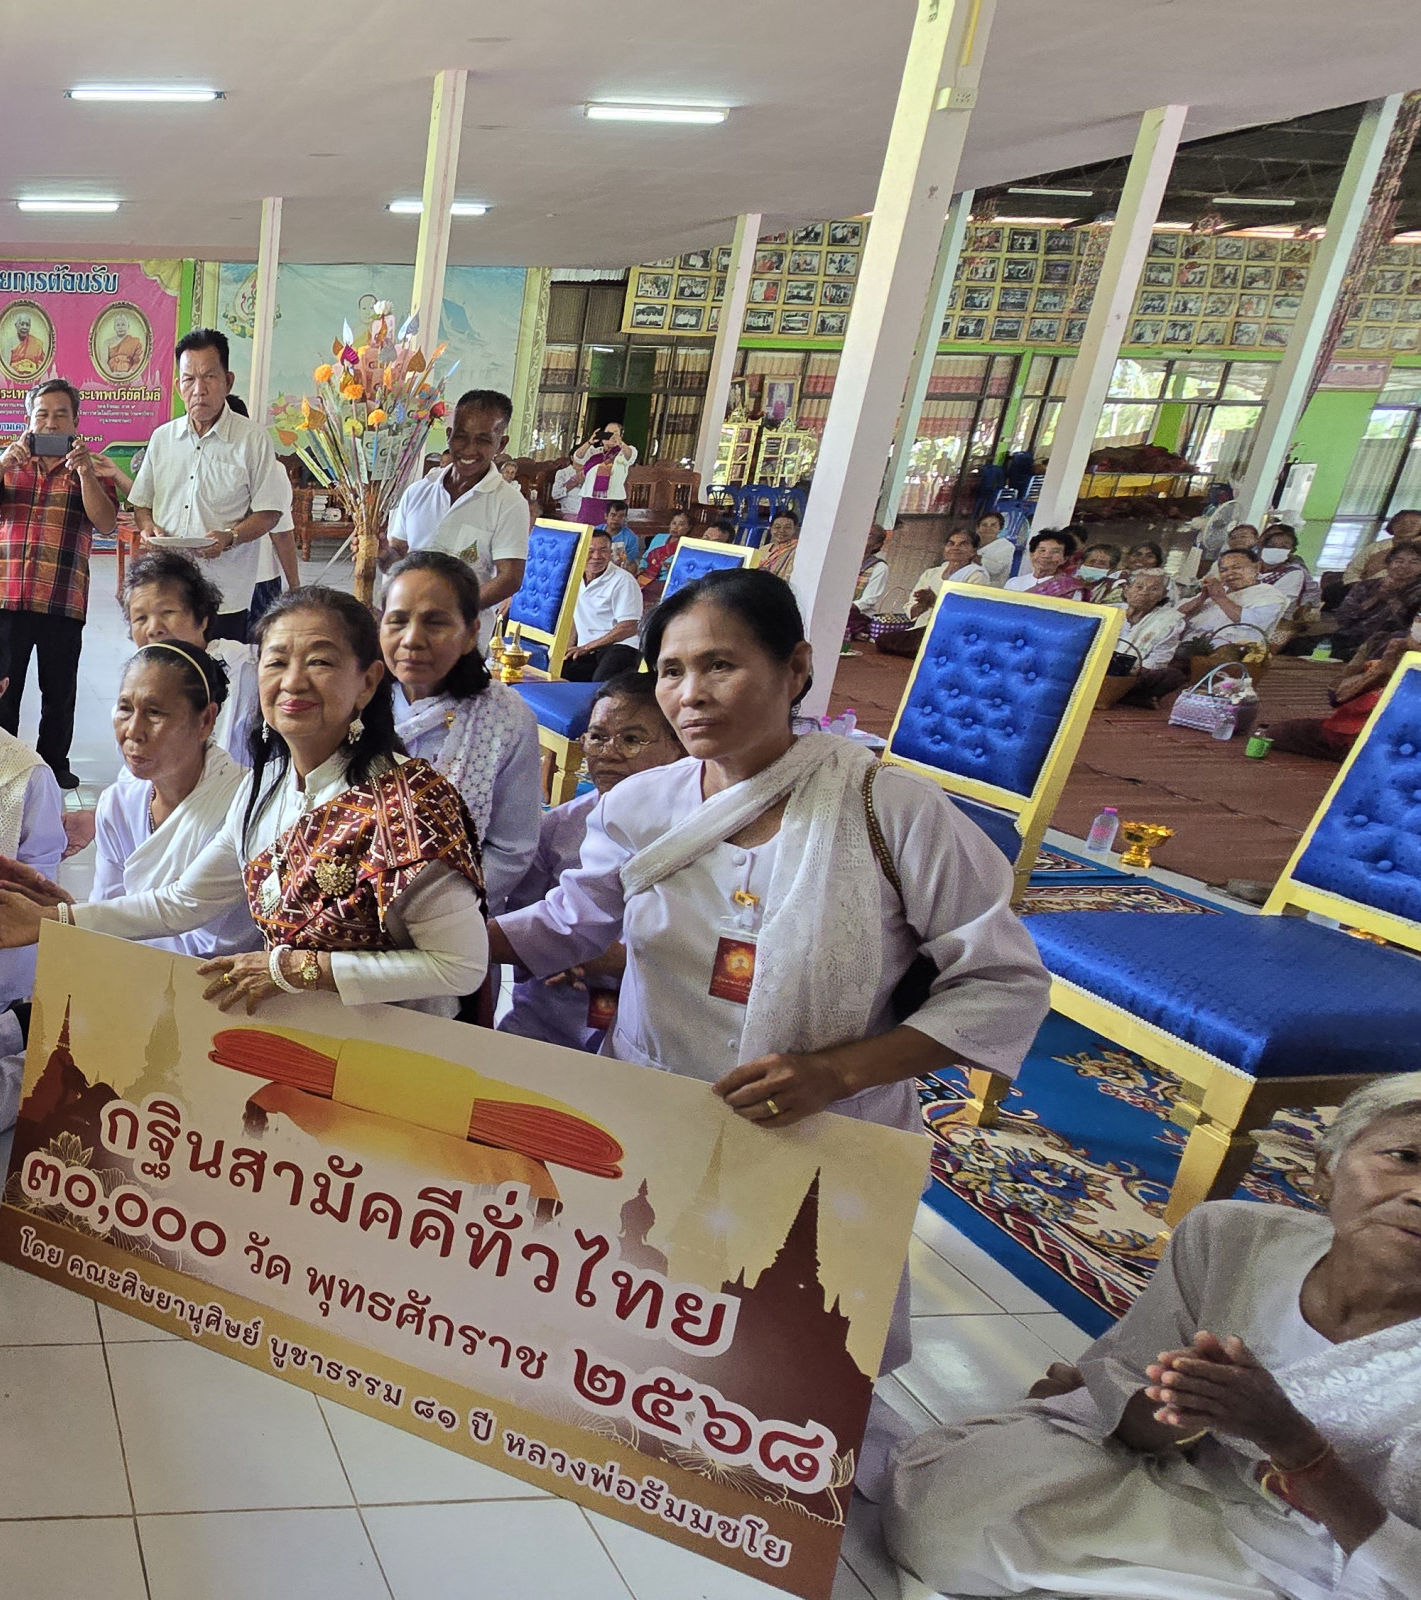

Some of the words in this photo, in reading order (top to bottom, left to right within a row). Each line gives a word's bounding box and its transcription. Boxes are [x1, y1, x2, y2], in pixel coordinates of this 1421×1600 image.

[78, 386, 162, 402] ระเทพปริยัติโมลี
[26, 1158, 227, 1258] ๓๐,๐๐๐
[243, 1231, 292, 1286] วัด
[306, 1266, 549, 1379] พุทธศักราช
[573, 1348, 825, 1483] ๒๕๖๘
[106, 1100, 727, 1347] กฐินสามัคคีทั่วไทย
[20, 1229, 62, 1265] โดย
[69, 1255, 261, 1347] คณะศิษยานุศิษย์
[270, 1336, 403, 1406] บูชาธรรม
[414, 1399, 457, 1429] ๘๑
[471, 1411, 494, 1441] ปี
[506, 1431, 787, 1564] หลวงพ่อธัมมชโย
